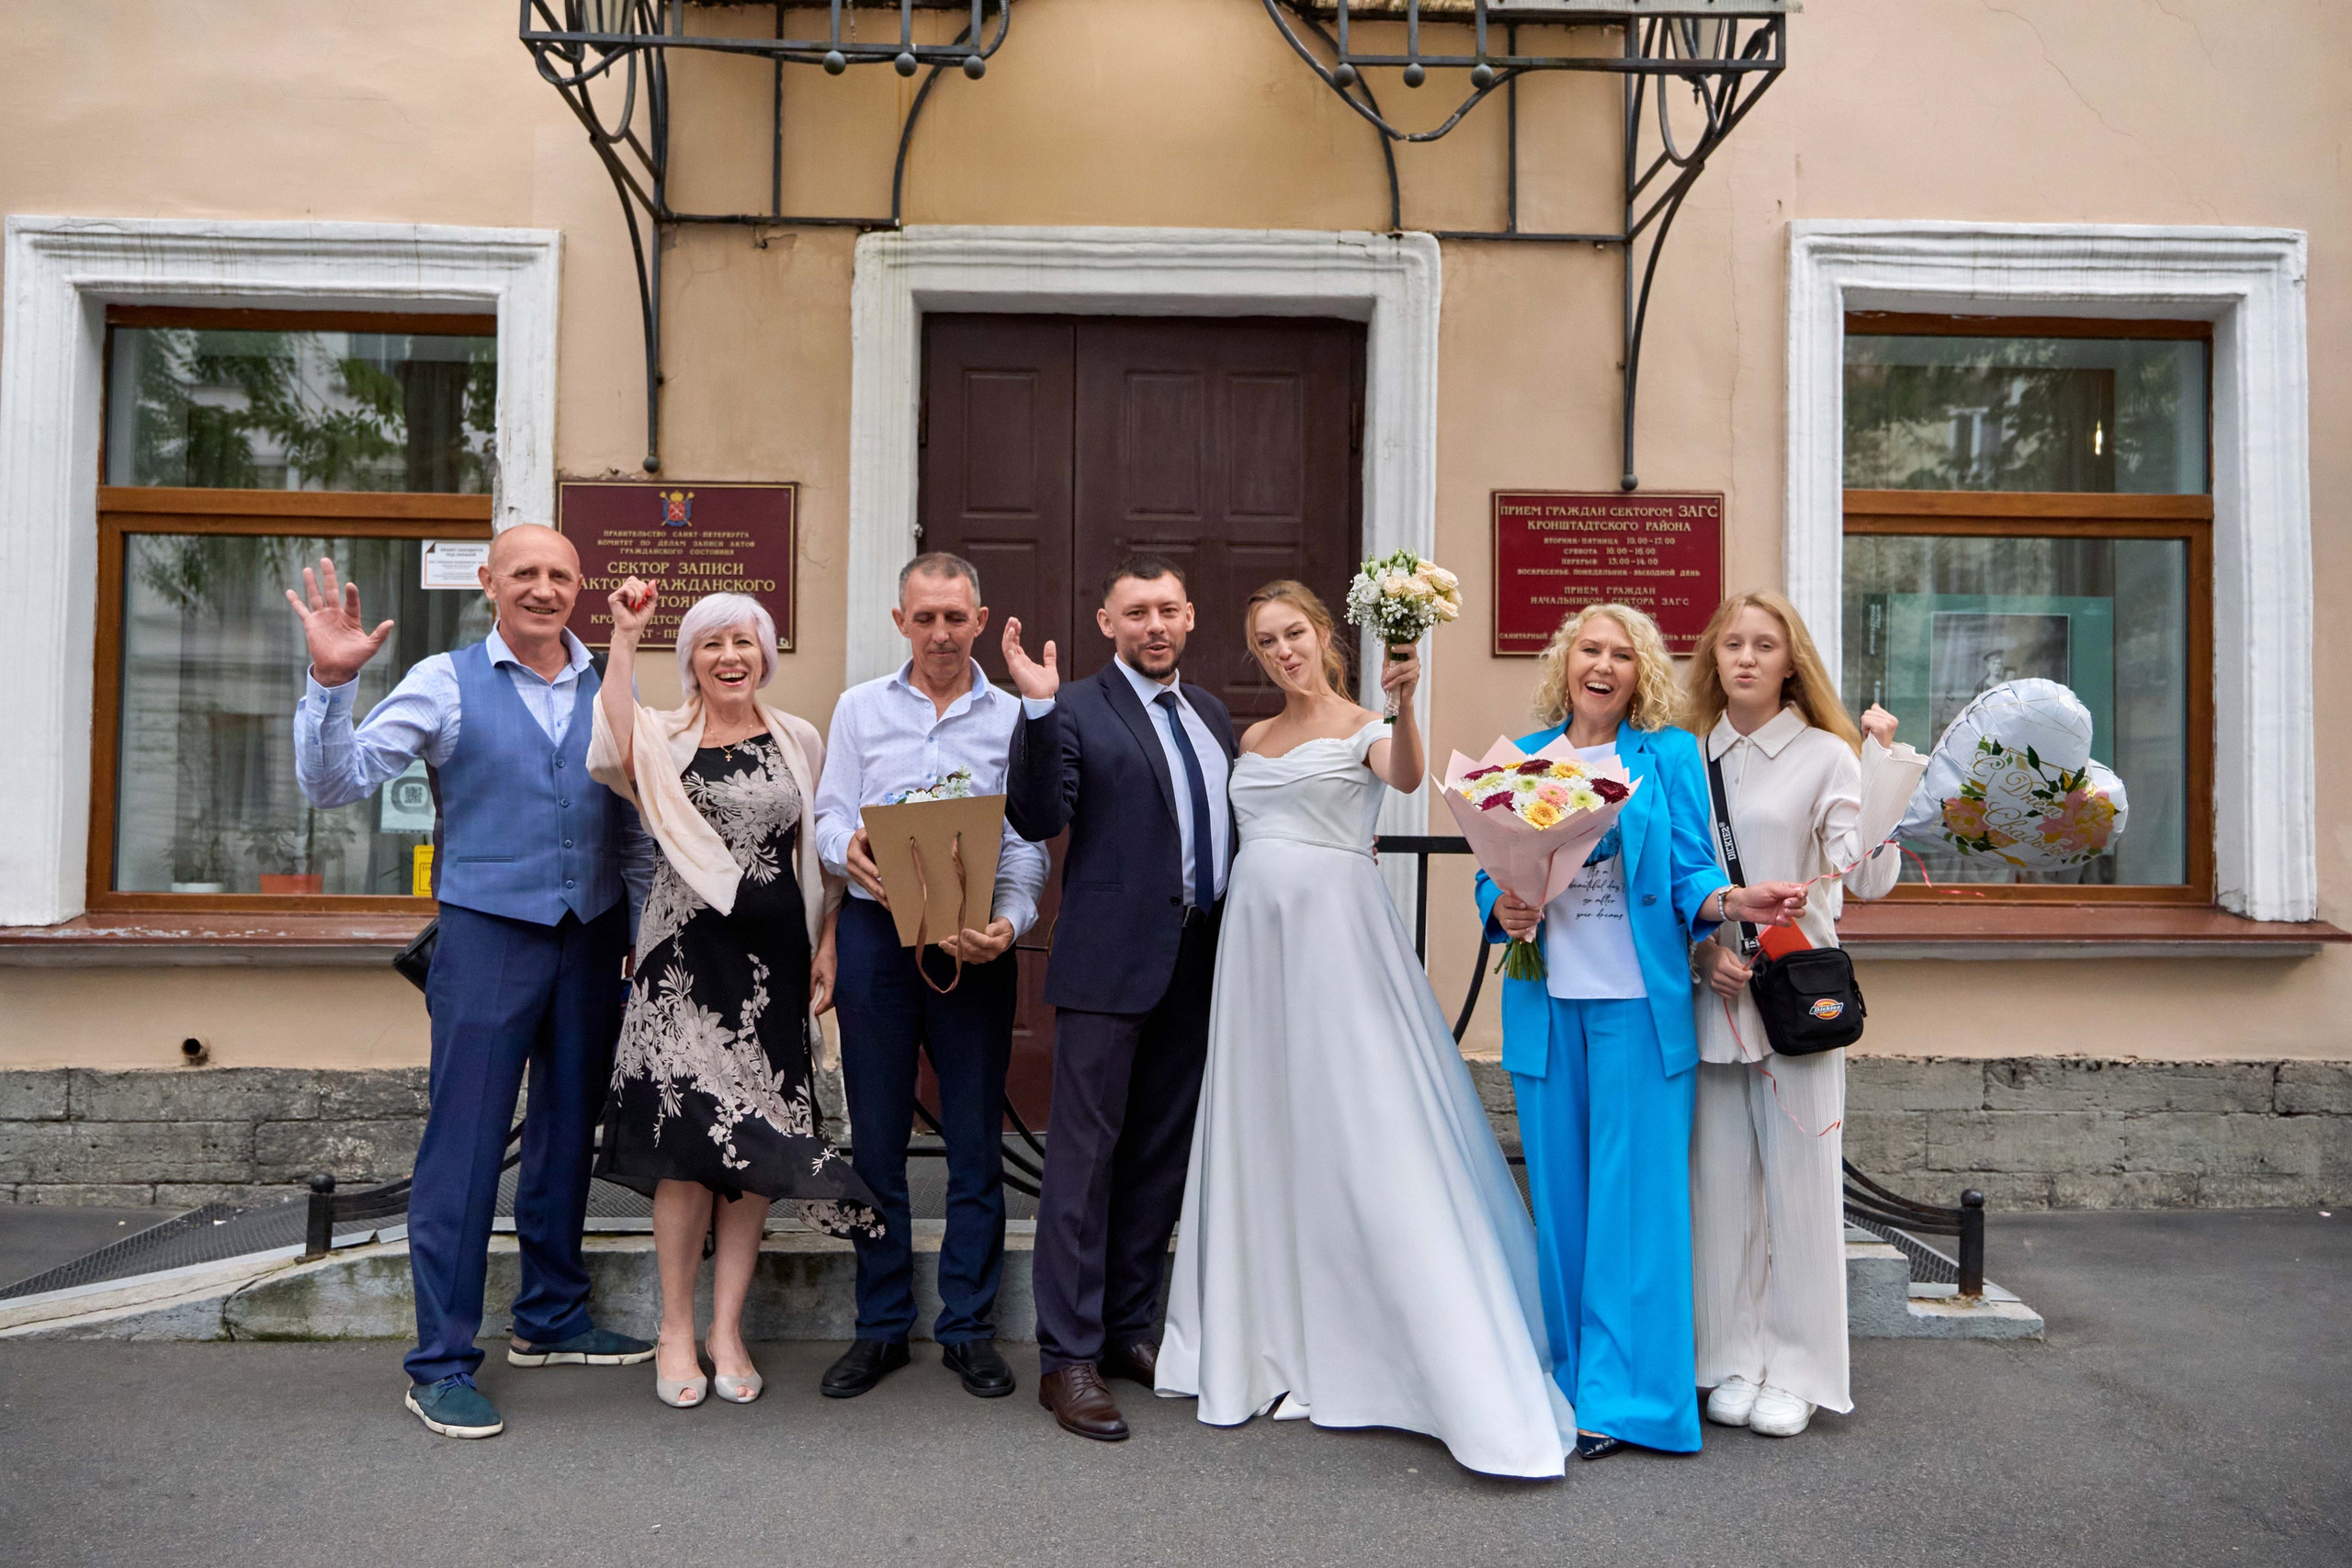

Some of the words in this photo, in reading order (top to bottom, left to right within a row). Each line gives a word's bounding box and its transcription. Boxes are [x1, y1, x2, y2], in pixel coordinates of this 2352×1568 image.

[1500, 505, 1542, 516] ПРИЕМ
[1545, 506, 1607, 517] ГРАЖДАН
[1610, 507, 1674, 517] СЕКТОРОМ
[1678, 504, 1718, 518] ЗАГС
[1527, 520, 1639, 532] КРОНШТАДТСКОГО
[1645, 520, 1691, 532] РАЙОНА
[604, 530, 667, 538] ПРАВИТЕЛЬСТВО
[606, 561, 670, 575] СЕКТОР
[678, 561, 744, 576] ЗАПИСИ
[1634, 568, 1676, 577] ВЫХОДНОЙ
[581, 577, 627, 591] АКТО
[1564, 586, 1599, 594] ПРИЕМ
[1606, 586, 1657, 595] ГРАЖДАН
[1531, 596, 1603, 604] НАЧАЛЬНИКОМ
[1611, 597, 1655, 605] СЕКТОРА
[1661, 597, 1690, 606] ЗАГС
[1814, 1004, 1841, 1013] Dickies
